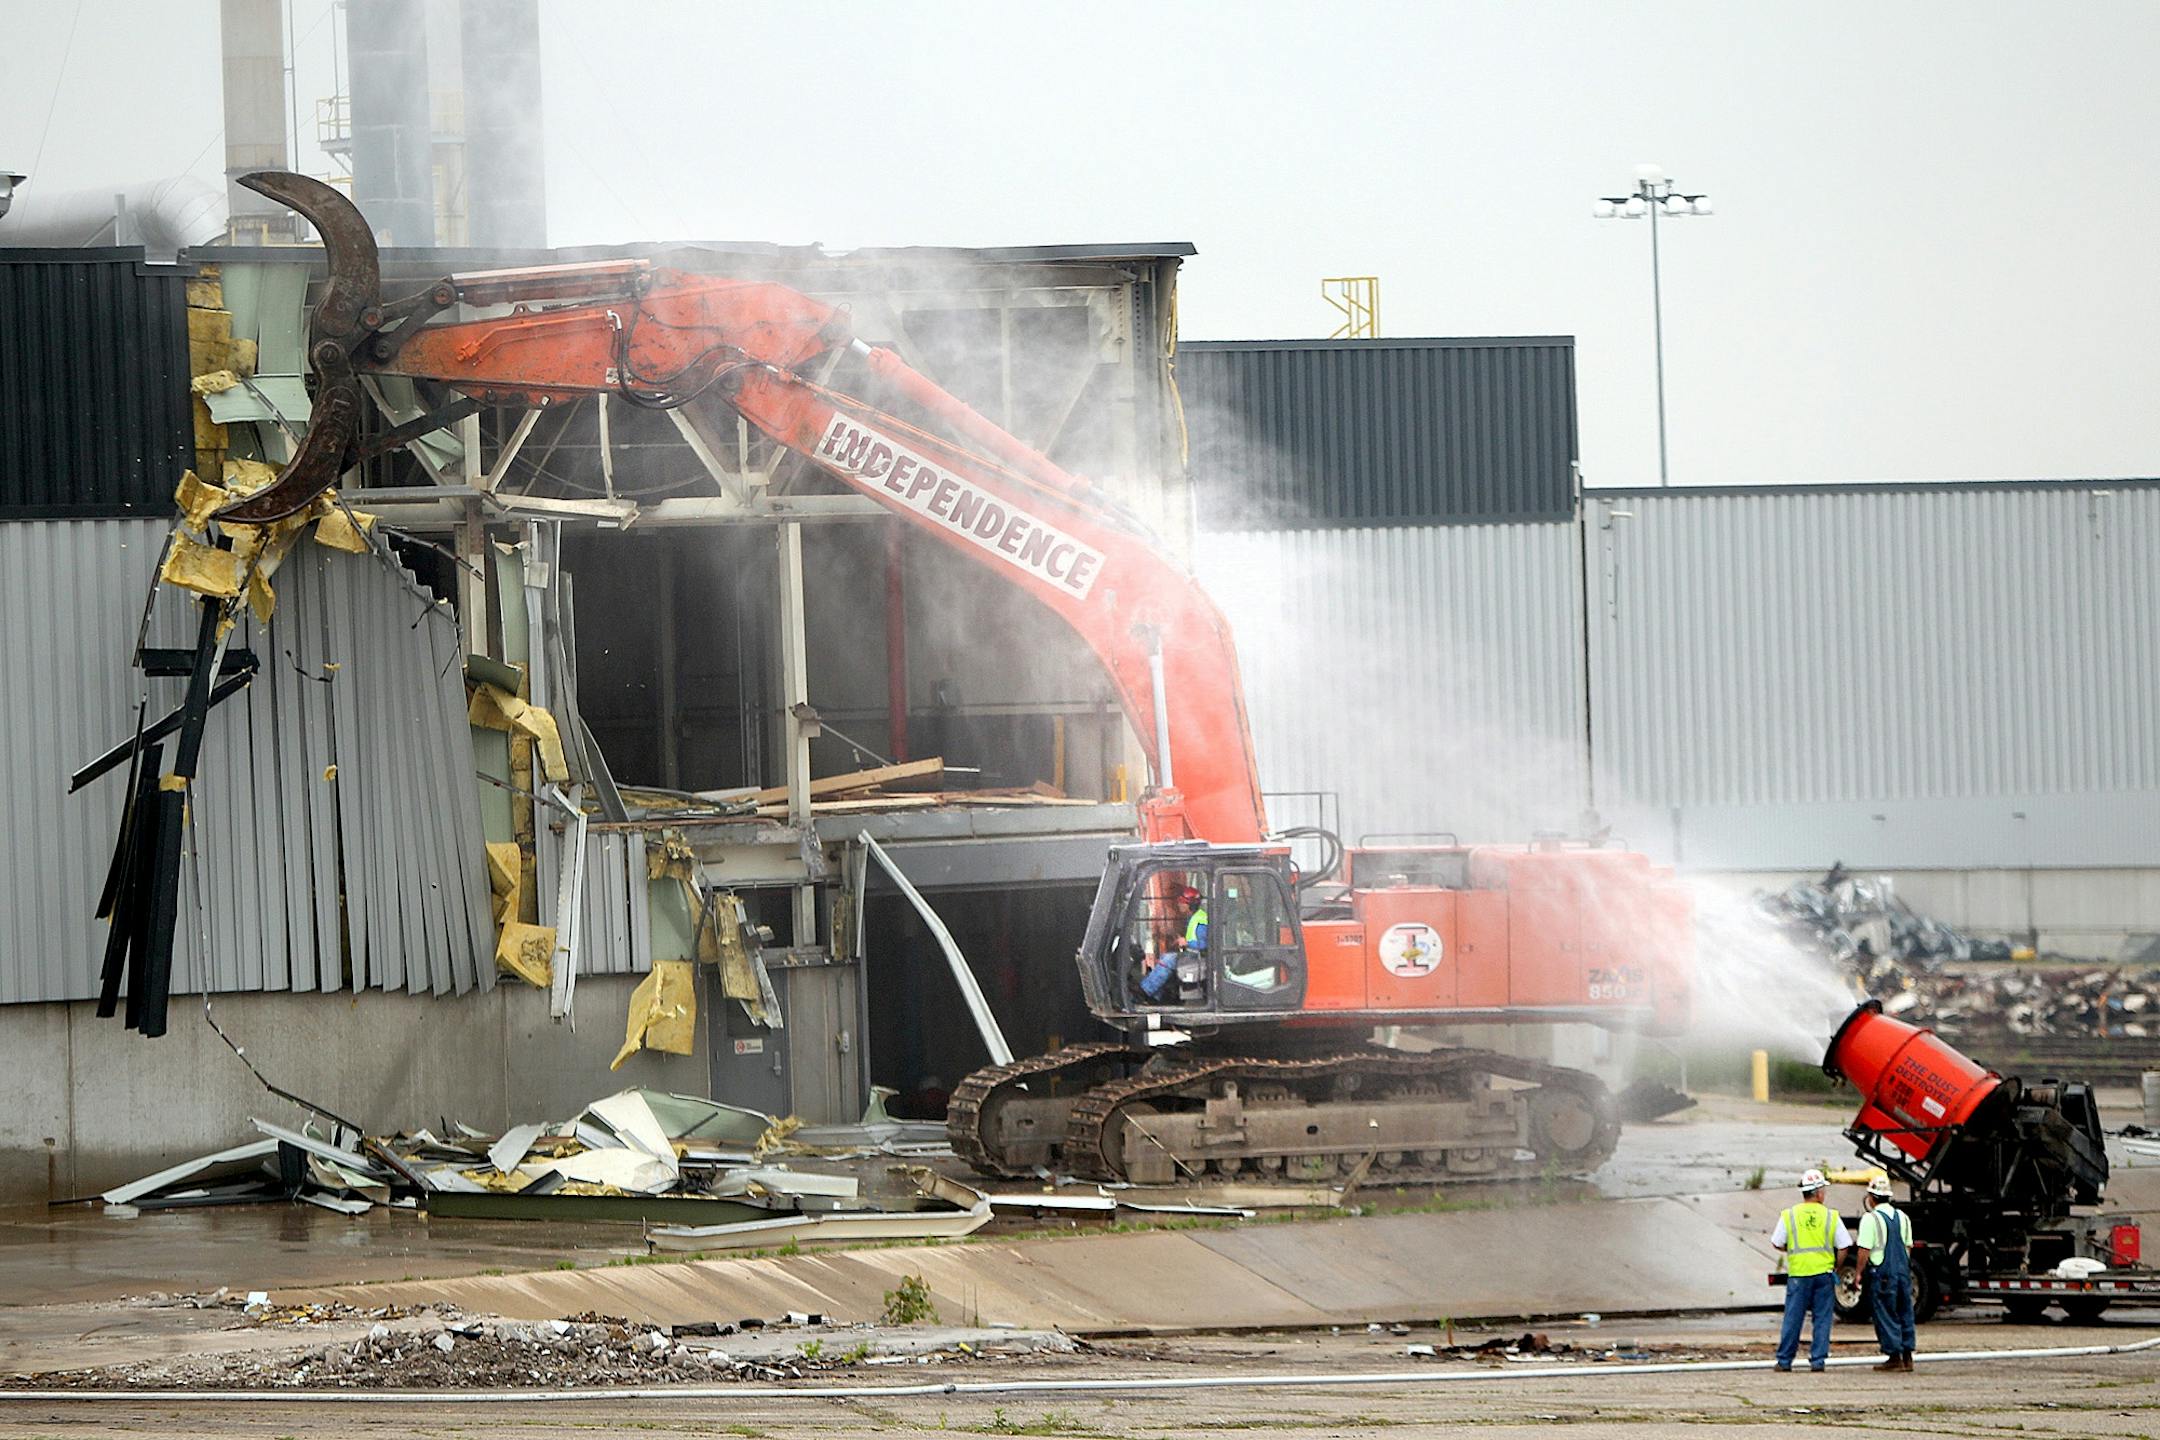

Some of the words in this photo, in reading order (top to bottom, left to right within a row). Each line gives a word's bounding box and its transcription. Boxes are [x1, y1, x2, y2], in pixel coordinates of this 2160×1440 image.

[822, 421, 1097, 589] INDEPENDENCE
[1896, 1065, 1952, 1104] DESTROYER
[1904, 1055, 1928, 1075] THE
[1927, 1072, 1960, 1095] DUST
